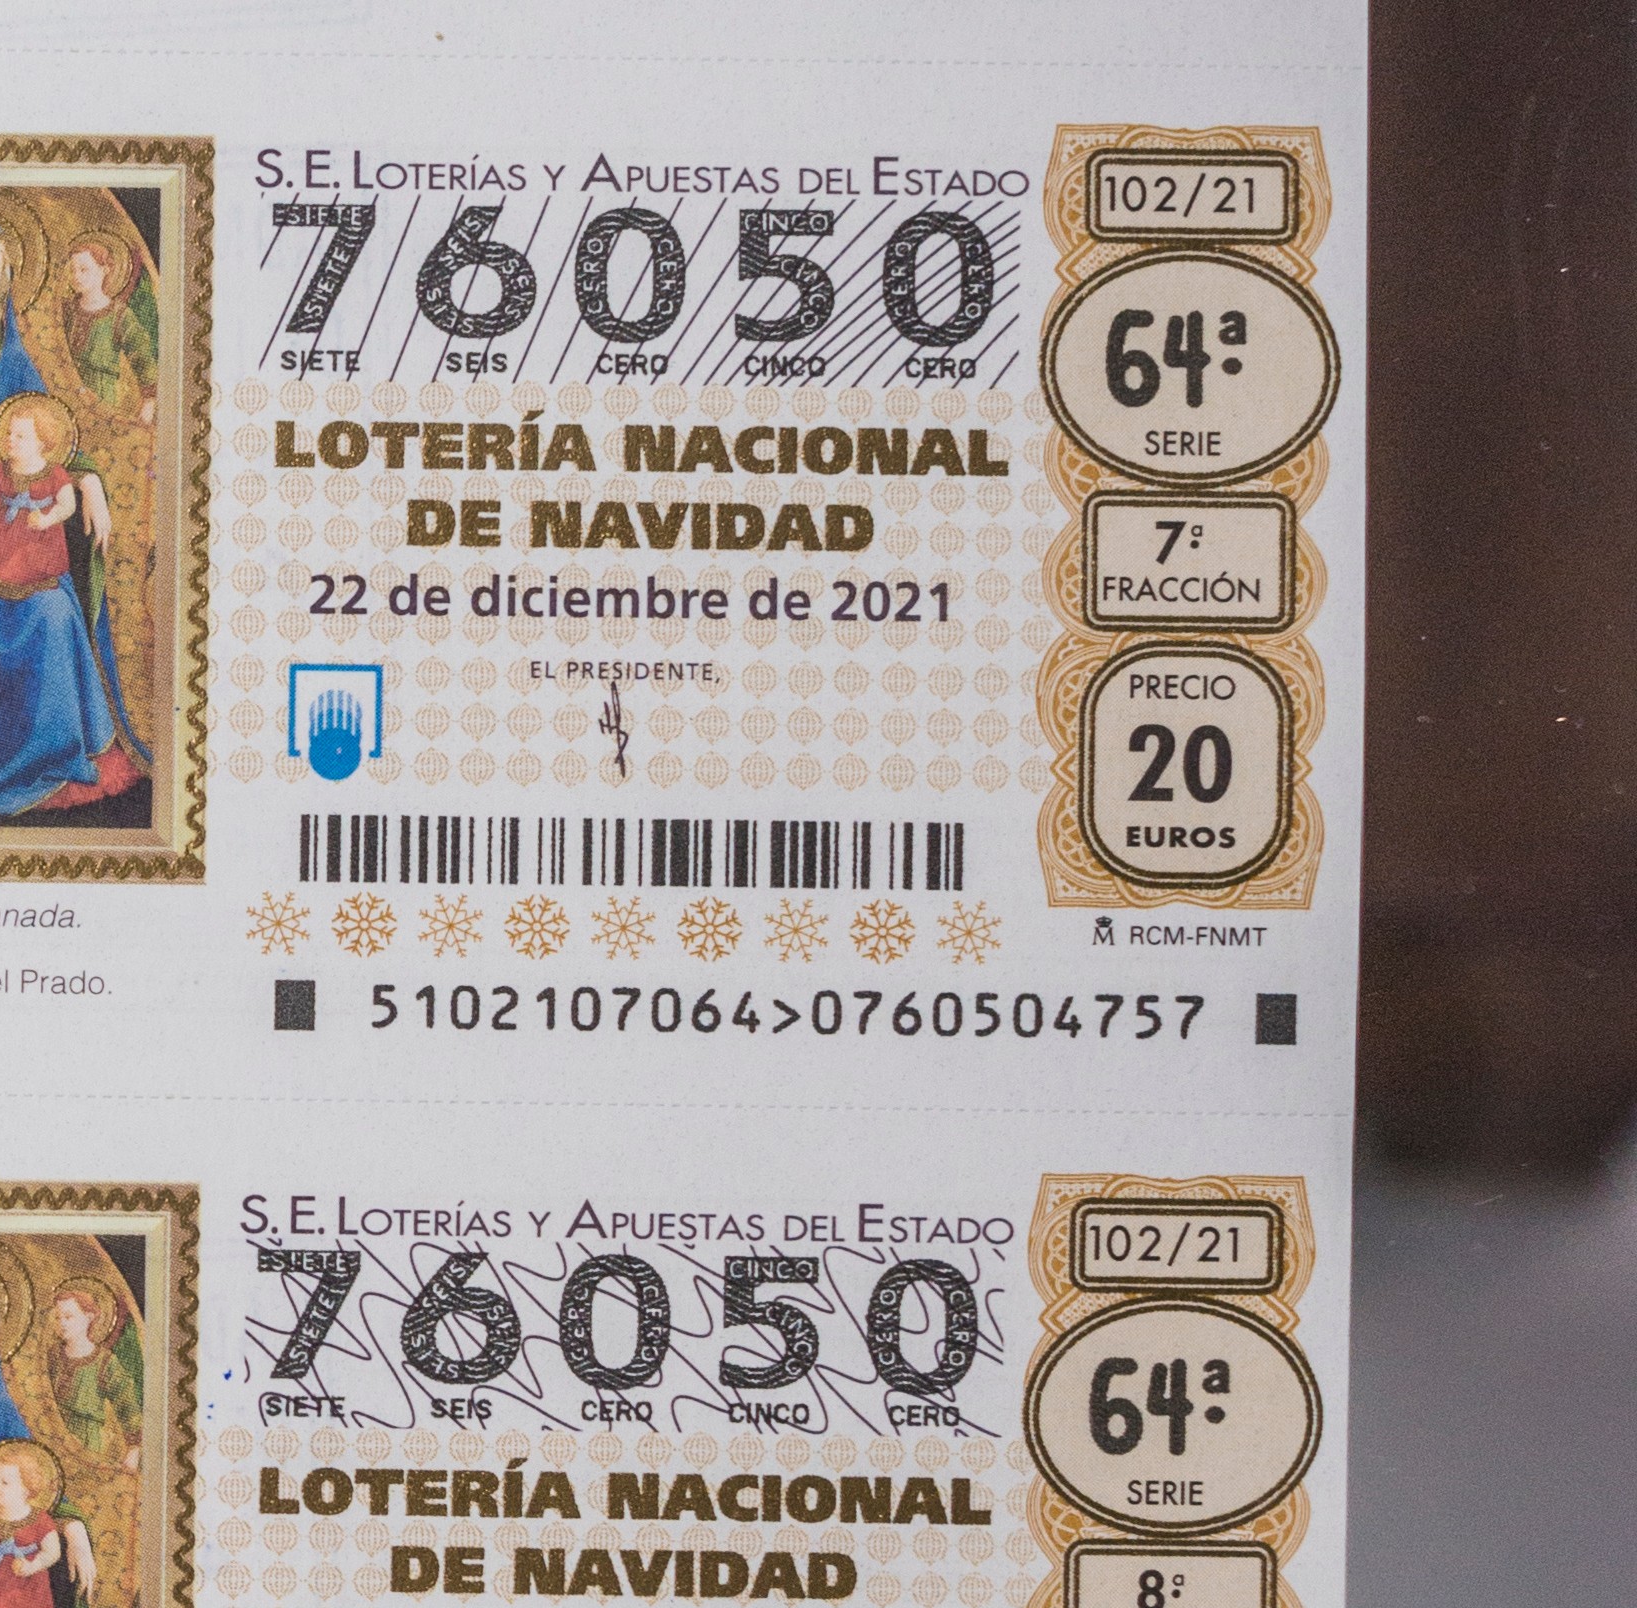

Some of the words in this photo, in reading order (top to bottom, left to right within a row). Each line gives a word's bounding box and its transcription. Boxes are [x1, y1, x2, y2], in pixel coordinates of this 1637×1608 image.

[1104, 172, 1256, 218] 102/21
[274, 202, 998, 349] 76050
[270, 408, 597, 472] LOTERÍA
[622, 421, 1009, 479] NACIONAL
[405, 497, 501, 548] DE
[529, 499, 875, 554] NAVIDAD
[20, 968, 113, 997] Prado.
[371, 984, 1205, 1040] 5102107064>0760504757
[1089, 1221, 1240, 1267] 102/21
[259, 1249, 982, 1396] 76050
[255, 1456, 581, 1520] LOTERÍA
[606, 1470, 992, 1527] NACIONAL
[1126, 1479, 1204, 1506] SERIE
[389, 1544, 485, 1595] DE
[512, 1546, 857, 1602] NAVIDAD
